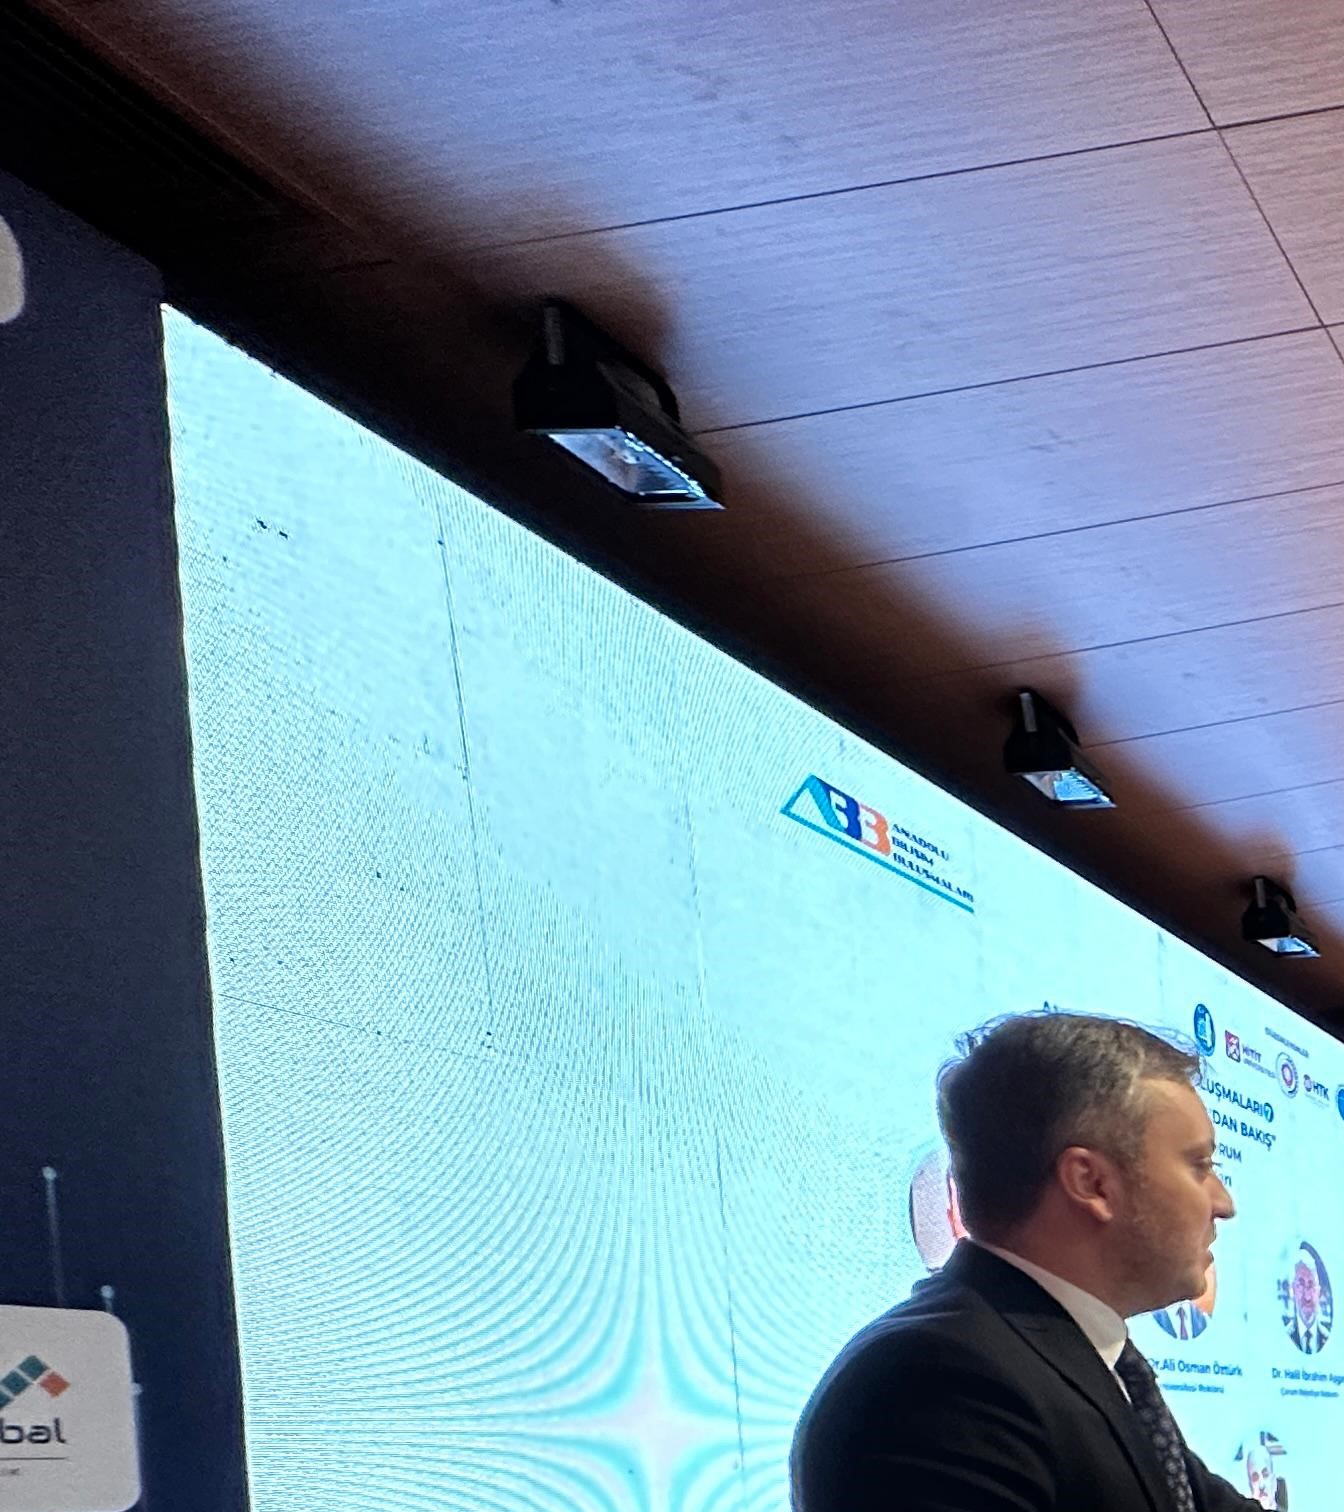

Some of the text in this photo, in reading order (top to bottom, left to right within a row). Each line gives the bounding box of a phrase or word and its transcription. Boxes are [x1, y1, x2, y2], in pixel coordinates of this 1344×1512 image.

[1201, 1078, 1263, 1117] LUŞMALARI
[1212, 1110, 1238, 1133] DAN
[1219, 1142, 1242, 1163] RUM
